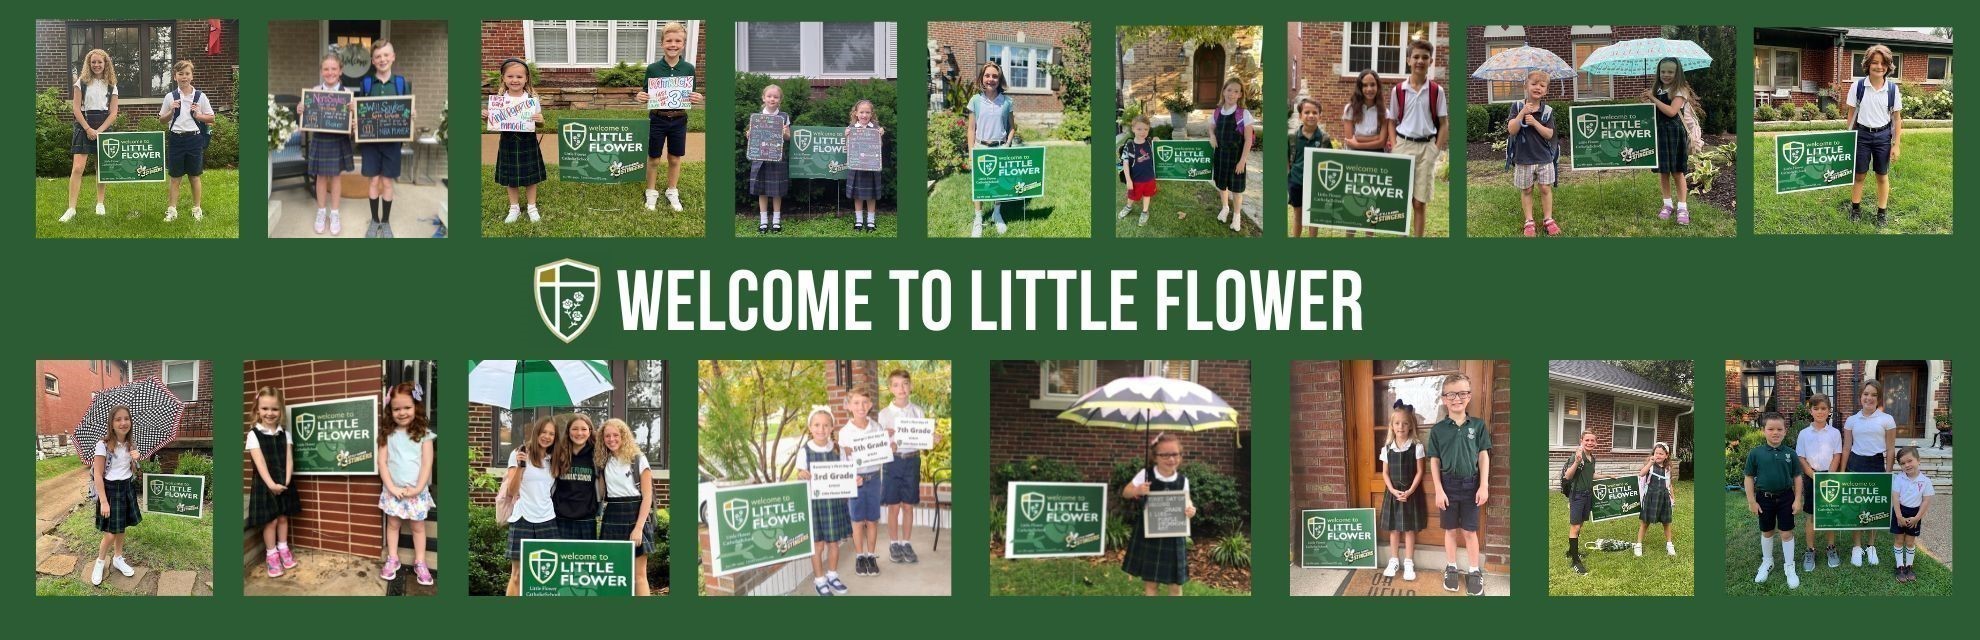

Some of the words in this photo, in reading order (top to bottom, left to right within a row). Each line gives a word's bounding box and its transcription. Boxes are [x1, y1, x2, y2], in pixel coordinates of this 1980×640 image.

[1601, 120, 1641, 129] LITTLE
[590, 133, 633, 141] LITTLE
[1601, 130, 1651, 139] FLOWER
[590, 143, 642, 152] FLOWER
[1806, 146, 1843, 156] LITTLE
[1806, 154, 1851, 164] FLOWER
[999, 160, 1032, 168] LITTLE
[1346, 164, 1377, 173] welcome
[999, 167, 1040, 176] FLOWER
[1346, 172, 1392, 186] LITTLE
[1345, 184, 1403, 199] FLOWER
[1378, 213, 1405, 222] STINGERS
[317, 418, 358, 430] LITTLE
[317, 429, 370, 441] FLOWER
[867, 441, 888, 449] Grade
[1608, 485, 1632, 494] LITTLE
[1609, 491, 1638, 500] FLOWER
[751, 496, 782, 505] welcome
[752, 502, 795, 517] LITTLE
[1047, 502, 1089, 511] LITTLE
[753, 512, 805, 530] FLOWER
[1046, 513, 1098, 522] FLOWER
[1328, 523, 1362, 531] LITTLE
[1328, 532, 1371, 540] FLOWER
[560, 552, 597, 560] welcome
[560, 562, 614, 573] LITTLE
[560, 575, 626, 586] FLOWER
